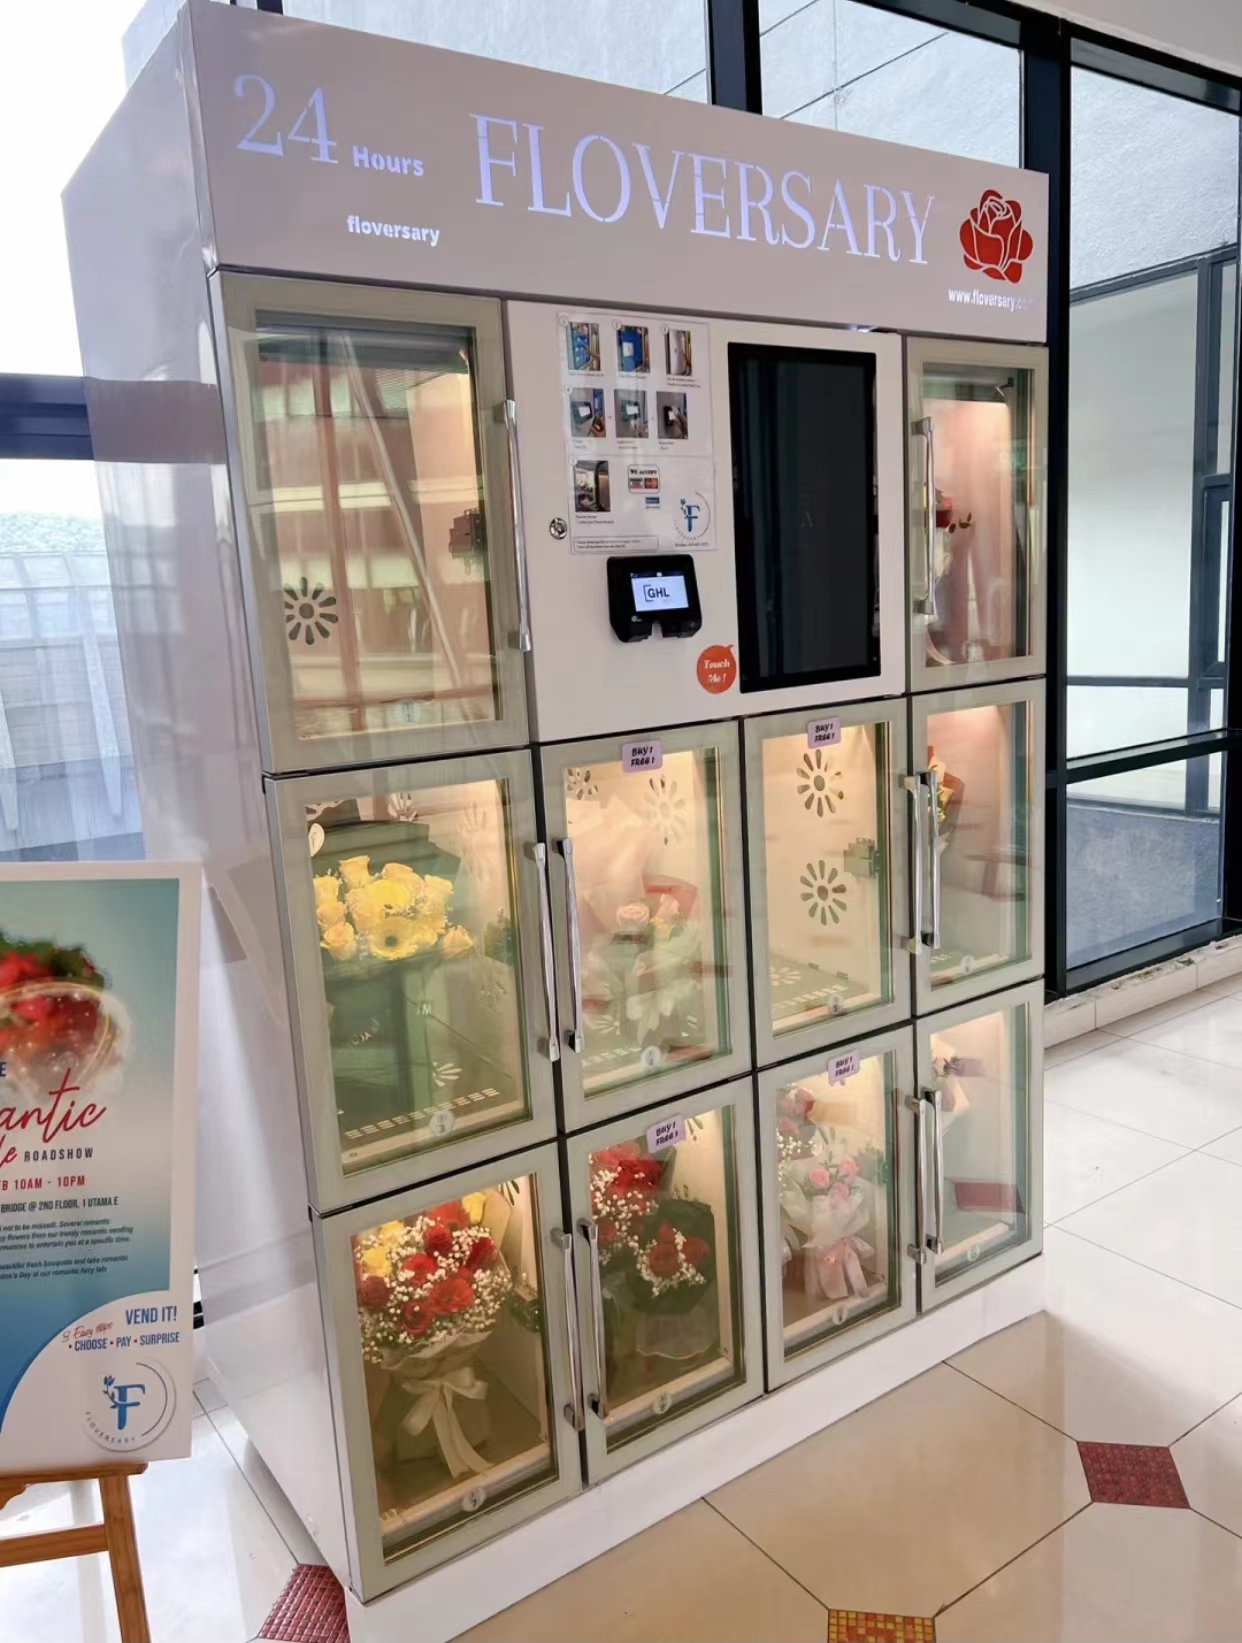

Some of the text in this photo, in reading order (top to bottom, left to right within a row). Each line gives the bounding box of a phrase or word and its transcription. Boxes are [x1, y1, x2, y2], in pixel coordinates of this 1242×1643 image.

[233, 73, 425, 177] 24 Hours
[469, 113, 935, 265] FLOVERSARY
[346, 214, 440, 247] floversary
[647, 587, 670, 599] GHL
[704, 658, 730, 669] Touch
[815, 724, 830, 733] BUY
[632, 746, 649, 757] BUY
[836, 1057, 849, 1068] BUY
[656, 1124, 672, 1137] BUY
[24, 1147, 93, 1162] ROADSHOW
[14, 1177, 42, 1190] 10AM
[57, 1175, 85, 1188] 10PM
[1, 1202, 27, 1213] BRIDGE
[28, 1201, 37, 1212] @
[38, 1200, 54, 1211] 2ND
[88, 1197, 112, 1207] UTAMA
[125, 1305, 177, 1325] VEND IT!
[74, 1325, 93, 1340] Easy
[74, 1331, 181, 1351] CHOOSE PAY SURPRISE
